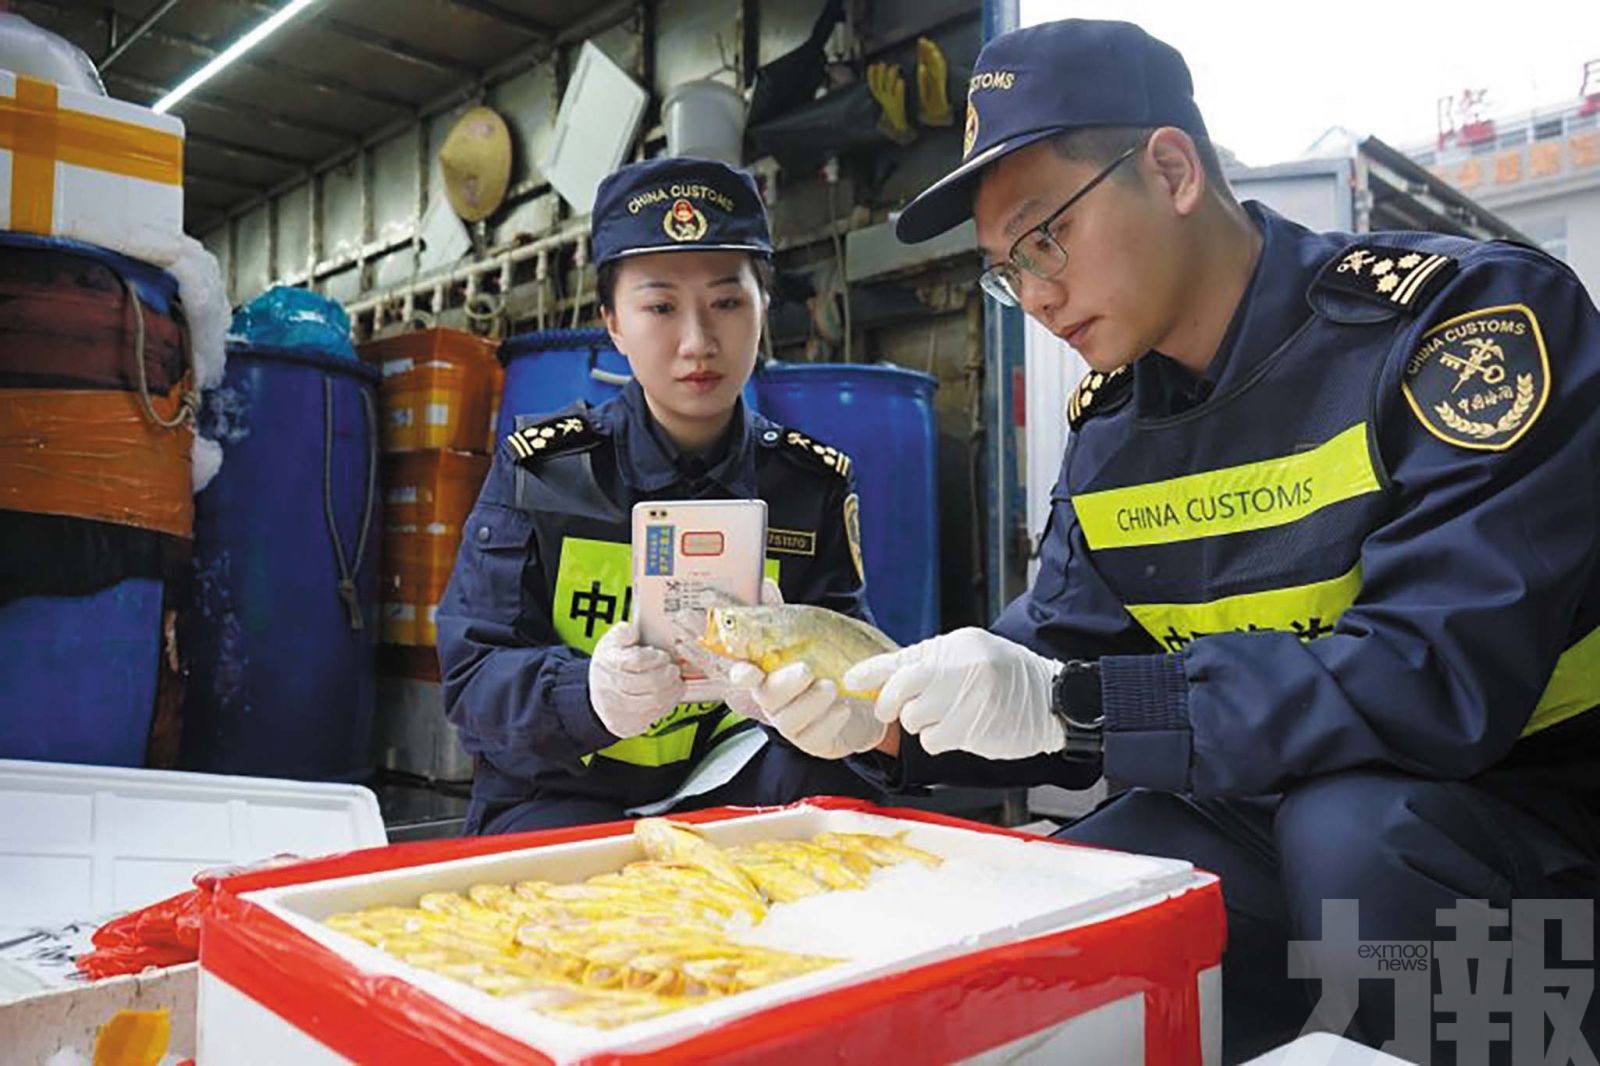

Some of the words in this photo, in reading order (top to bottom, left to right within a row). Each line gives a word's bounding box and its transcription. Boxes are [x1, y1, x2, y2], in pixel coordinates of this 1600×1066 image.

[627, 188, 669, 214] CHINA
[670, 185, 735, 212] CUSTOMS
[1407, 337, 1444, 374] CHINA
[1444, 319, 1526, 342] CUSTOMS
[1117, 502, 1179, 532] CHINA
[1186, 477, 1313, 523] CUSTOMS
[570, 580, 632, 638] 中
